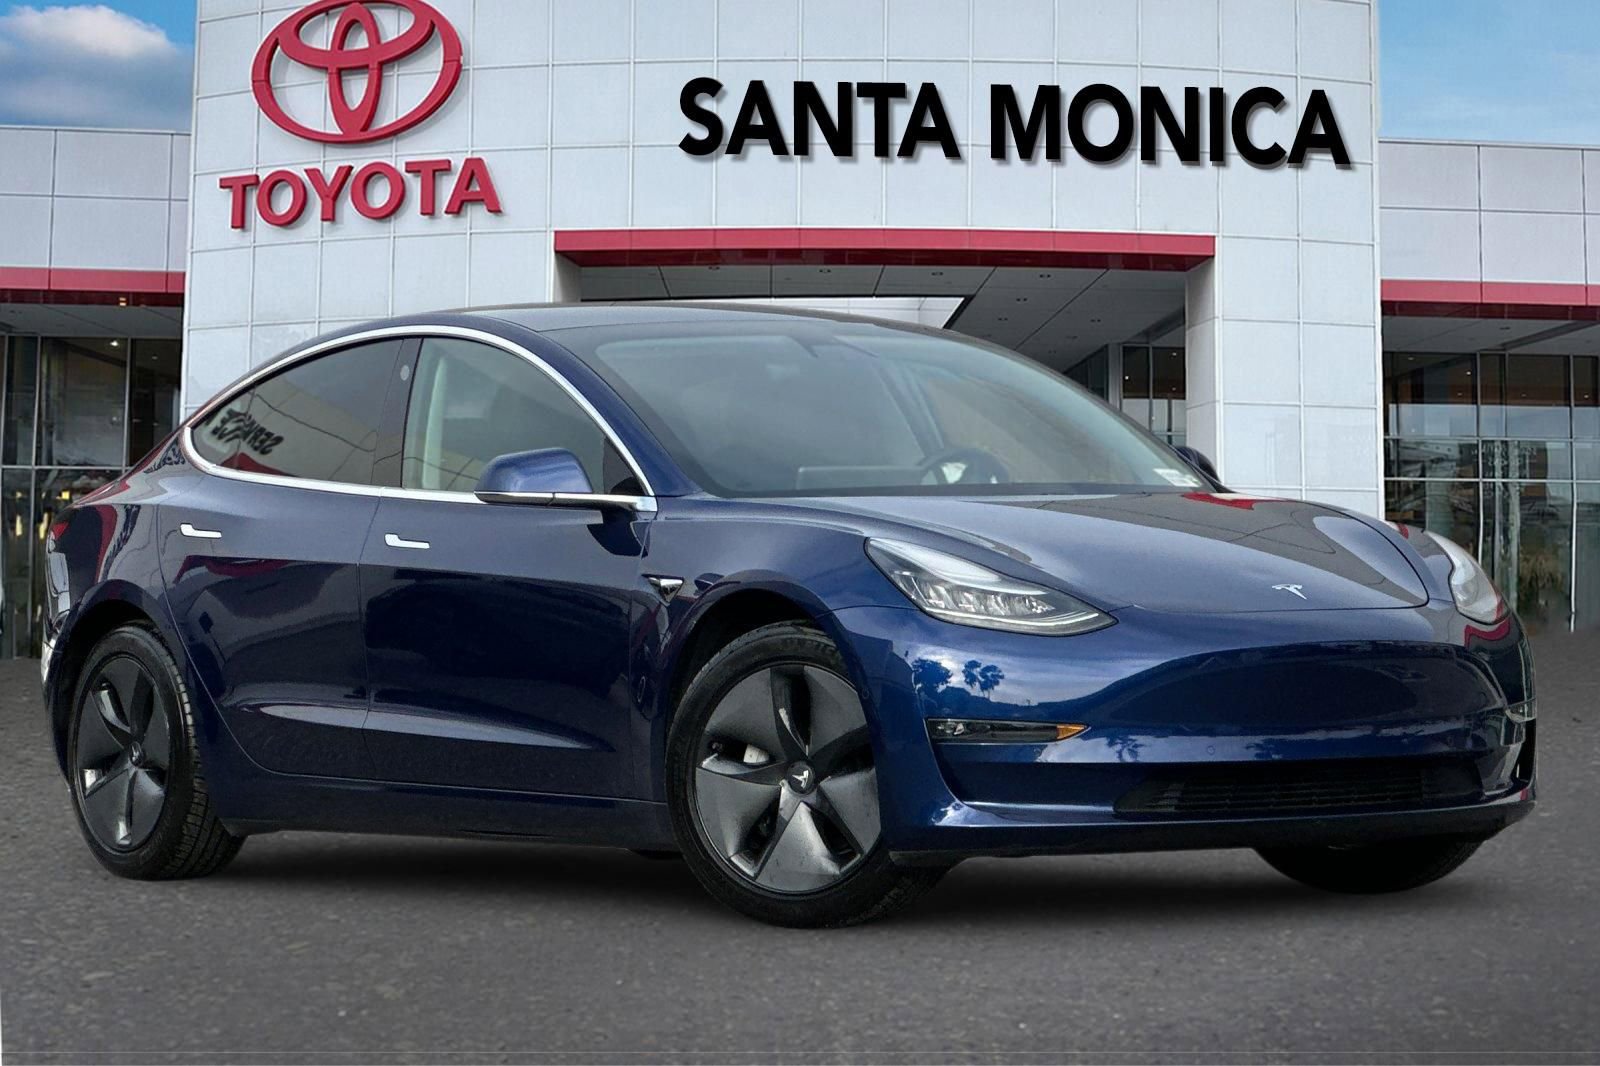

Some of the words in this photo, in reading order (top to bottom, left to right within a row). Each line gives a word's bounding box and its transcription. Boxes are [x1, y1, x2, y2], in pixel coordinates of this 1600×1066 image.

[678, 77, 961, 159] SANTA
[990, 83, 1351, 168] MONICA
[219, 157, 502, 229] TOYOTA
